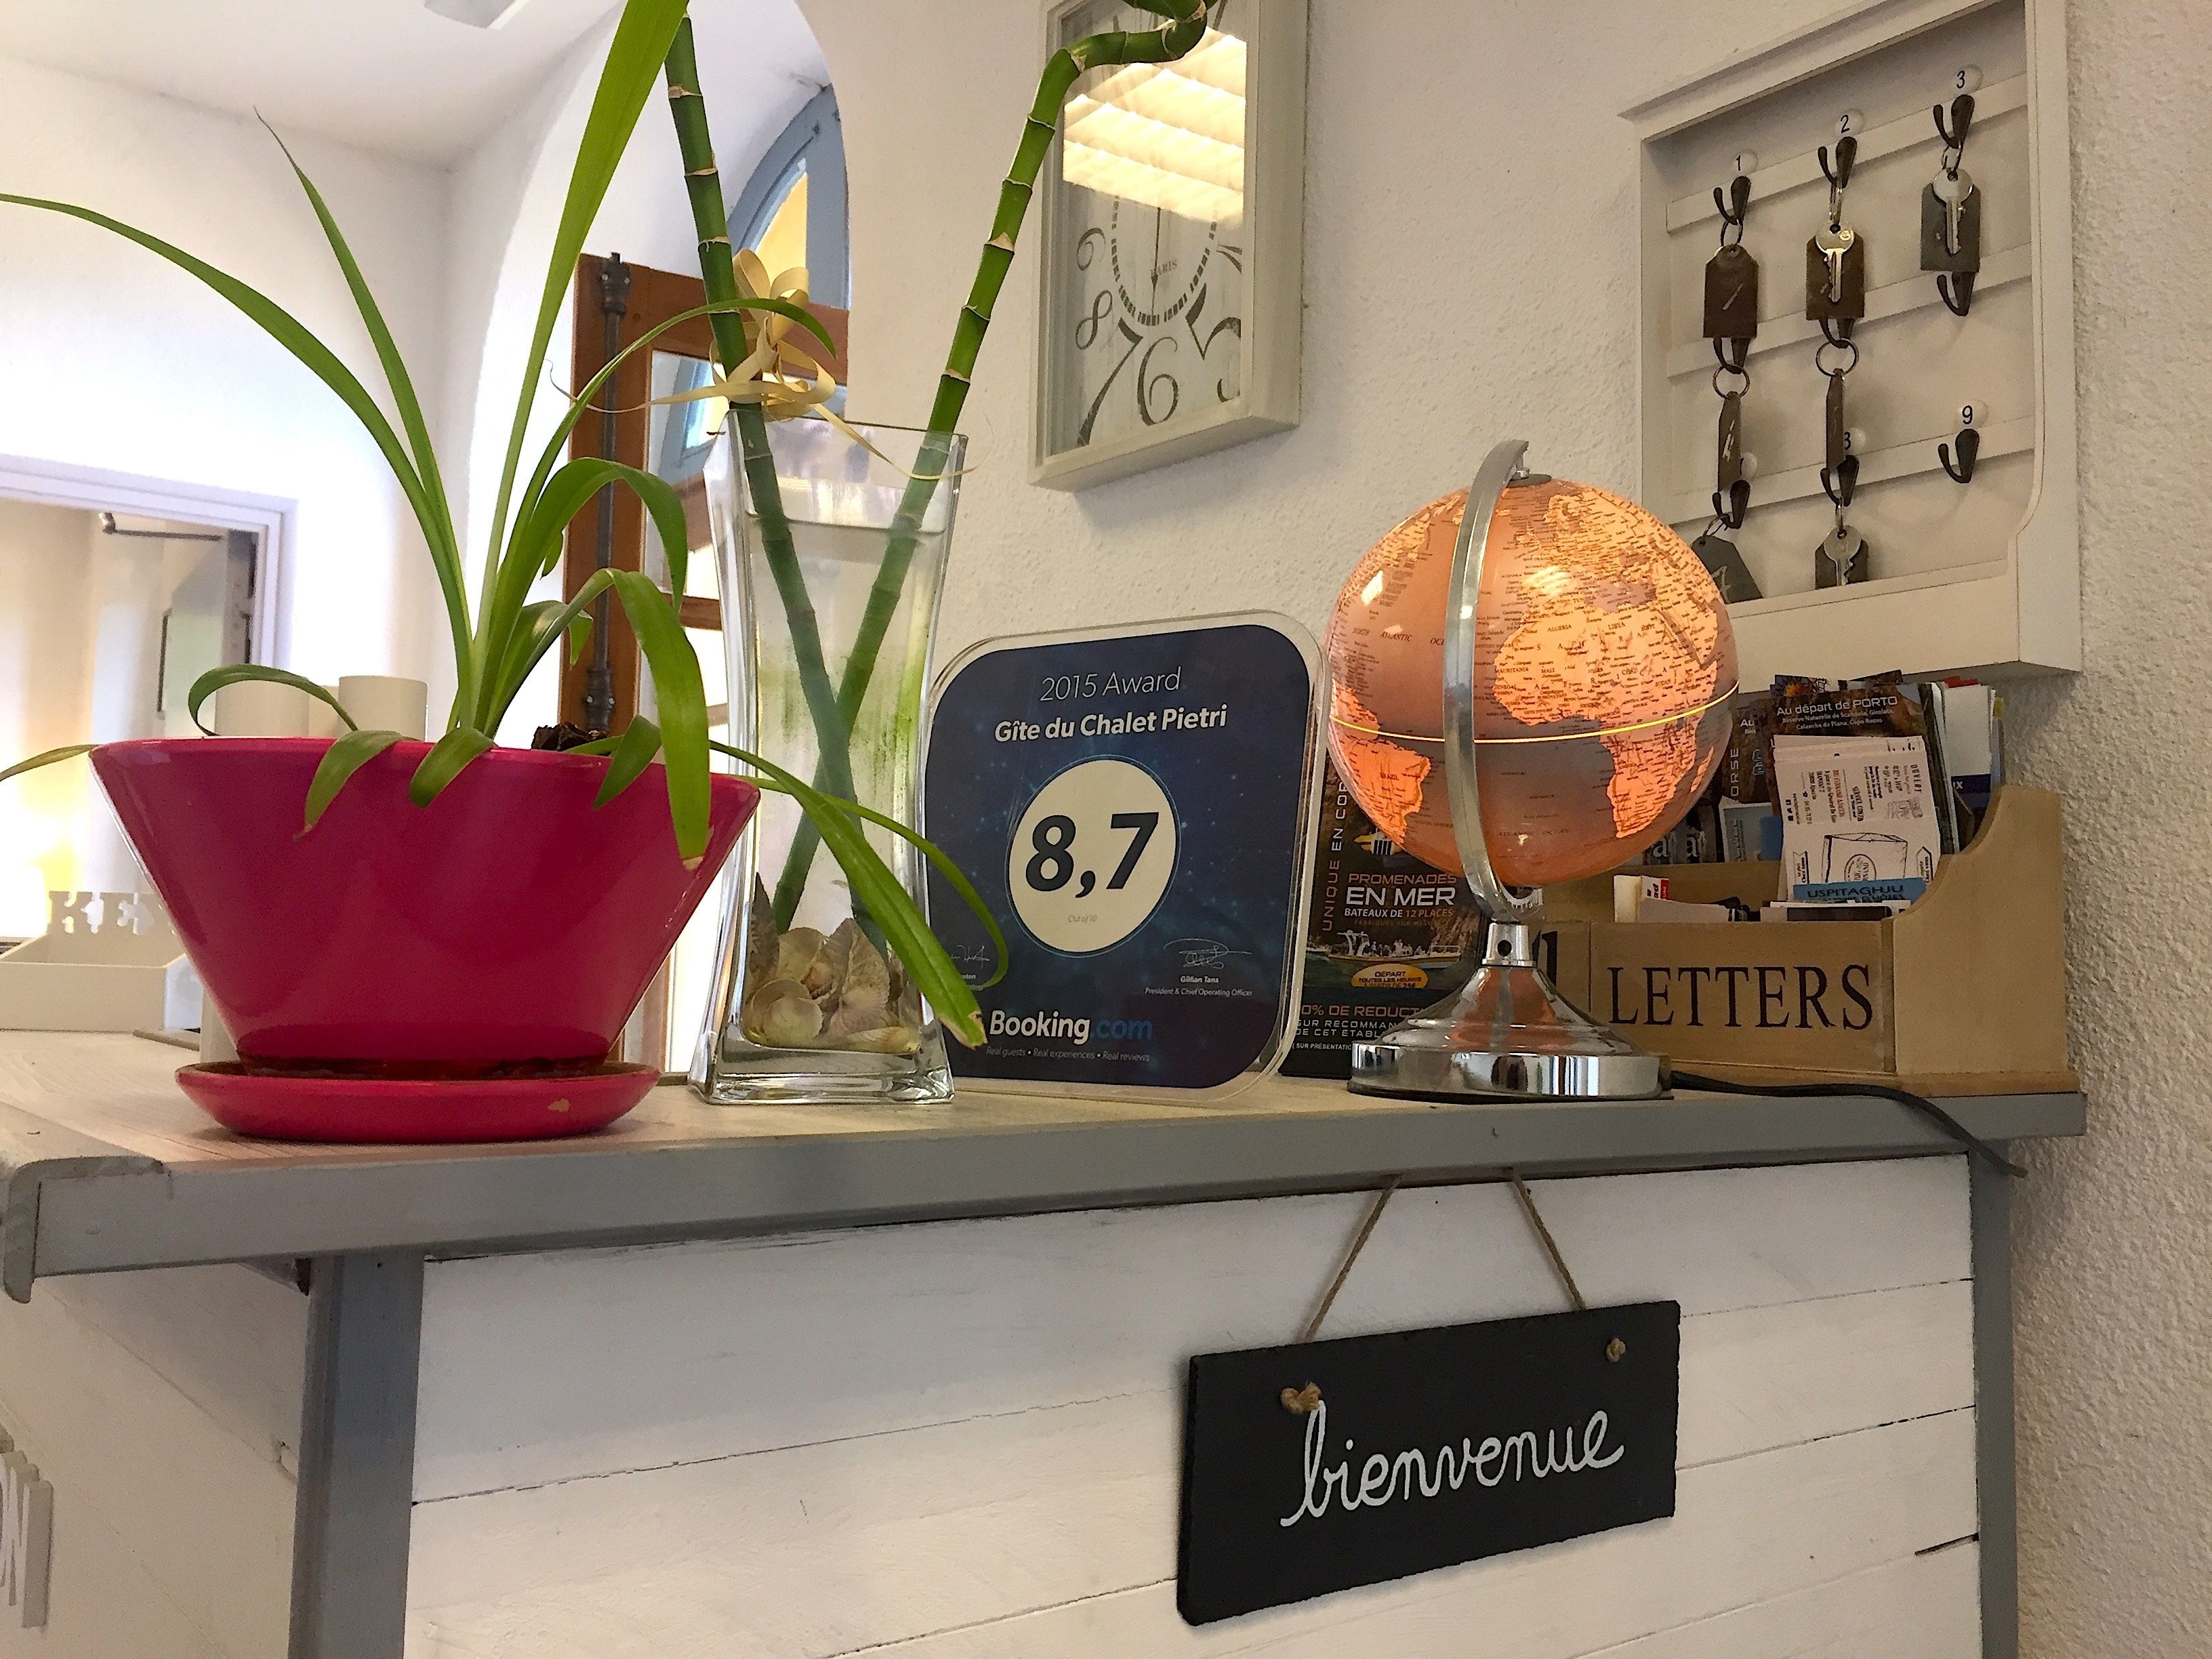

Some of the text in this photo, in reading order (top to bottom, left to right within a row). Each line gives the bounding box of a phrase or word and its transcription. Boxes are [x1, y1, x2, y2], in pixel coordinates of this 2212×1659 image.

[1956, 70, 1965, 89] 3
[1840, 115, 1851, 133] 2
[1736, 155, 1741, 171] 1
[1151, 259, 1178, 278] ARIS
[1075, 289, 1113, 350] 8
[1185, 283, 1242, 403] 5
[1076, 316, 1143, 447] 7
[1136, 336, 1178, 426] 6
[1962, 405, 1973, 424] 9
[1040, 666, 1183, 701] 2015 Award
[1776, 696, 1898, 716] Au départ de PORTO
[994, 703, 1228, 743] Gîte du Chalet Pietri
[1025, 812, 1160, 898] 8,7
[1322, 860, 1340, 932] UNIQUE
[1331, 827, 1344, 852] EN
[1348, 873, 1457, 885] PROMENADES
[1346, 886, 1456, 906] EN MER
[1807, 885, 1904, 899] USPITAGHJU
[1345, 908, 1453, 918] BATEAUX DE 12 PLACES
[1181, 987, 1197, 996] Chief
[1198, 988, 1231, 998] Operating
[1607, 964, 1873, 1031] LETTERS
[1329, 1006, 1350, 1016] DE
[989, 1010, 1153, 1045] Booking.com
[986, 1046, 1026, 1057] Real guests
[1050, 1050, 1095, 1059] experiences
[1103, 1050, 1150, 1062] Real reviews
[1279, 1399, 1625, 1527] bienvenue
